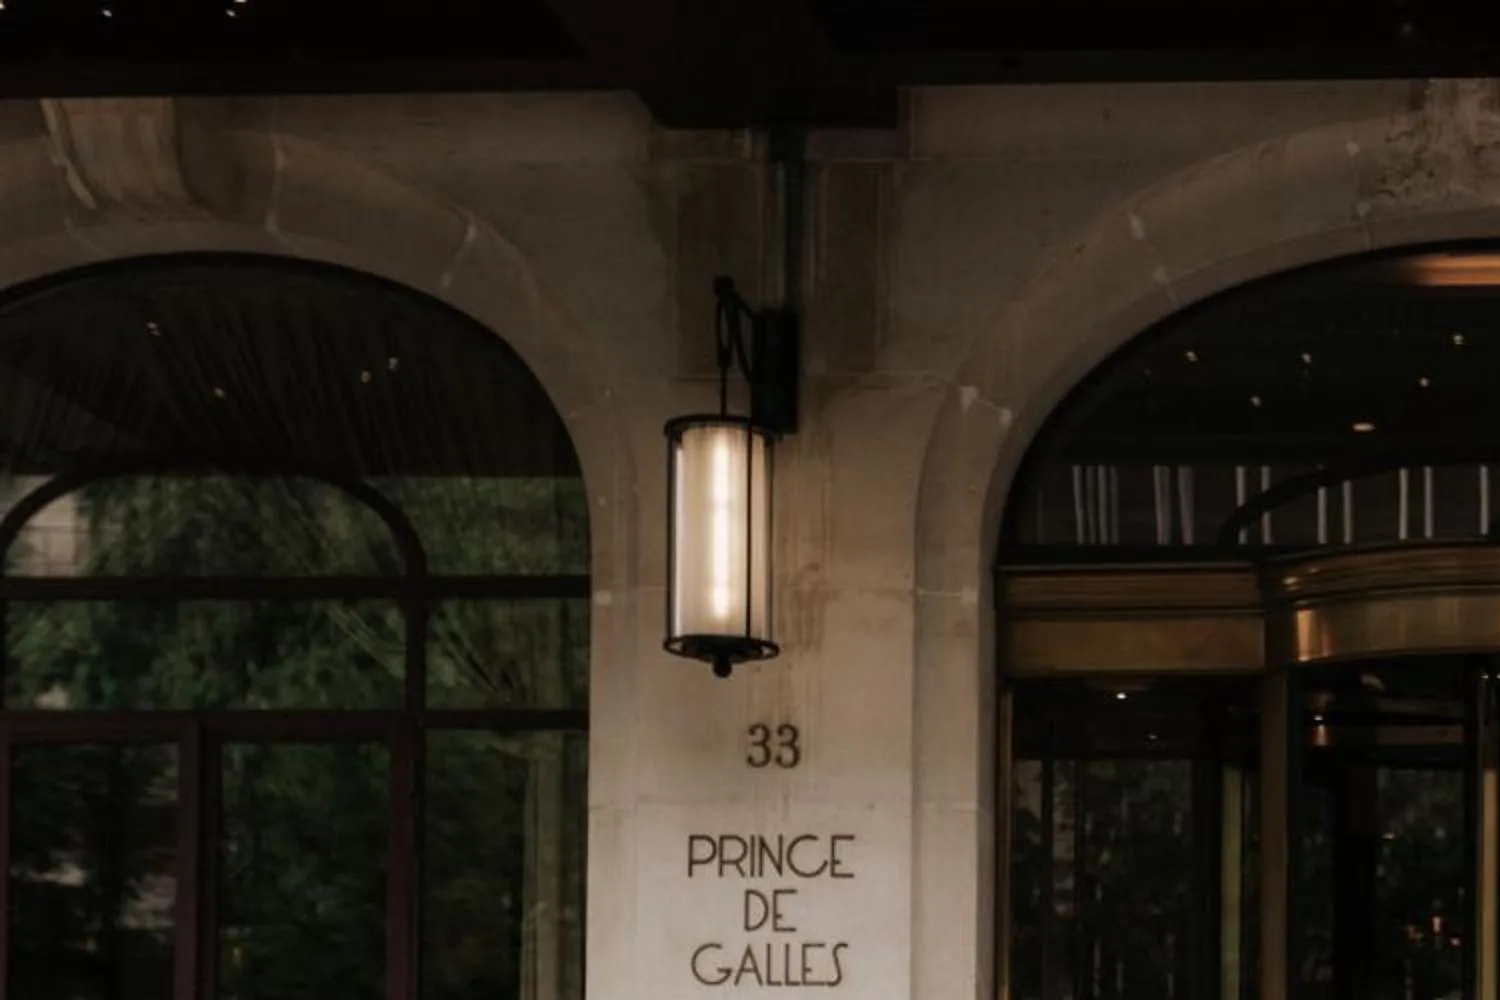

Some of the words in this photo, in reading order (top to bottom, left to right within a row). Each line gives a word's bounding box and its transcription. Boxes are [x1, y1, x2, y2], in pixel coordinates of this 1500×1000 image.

[746, 723, 800, 769] 33
[688, 834, 855, 877] PRINCE
[743, 889, 797, 932] DE
[691, 943, 849, 986] GALLES
